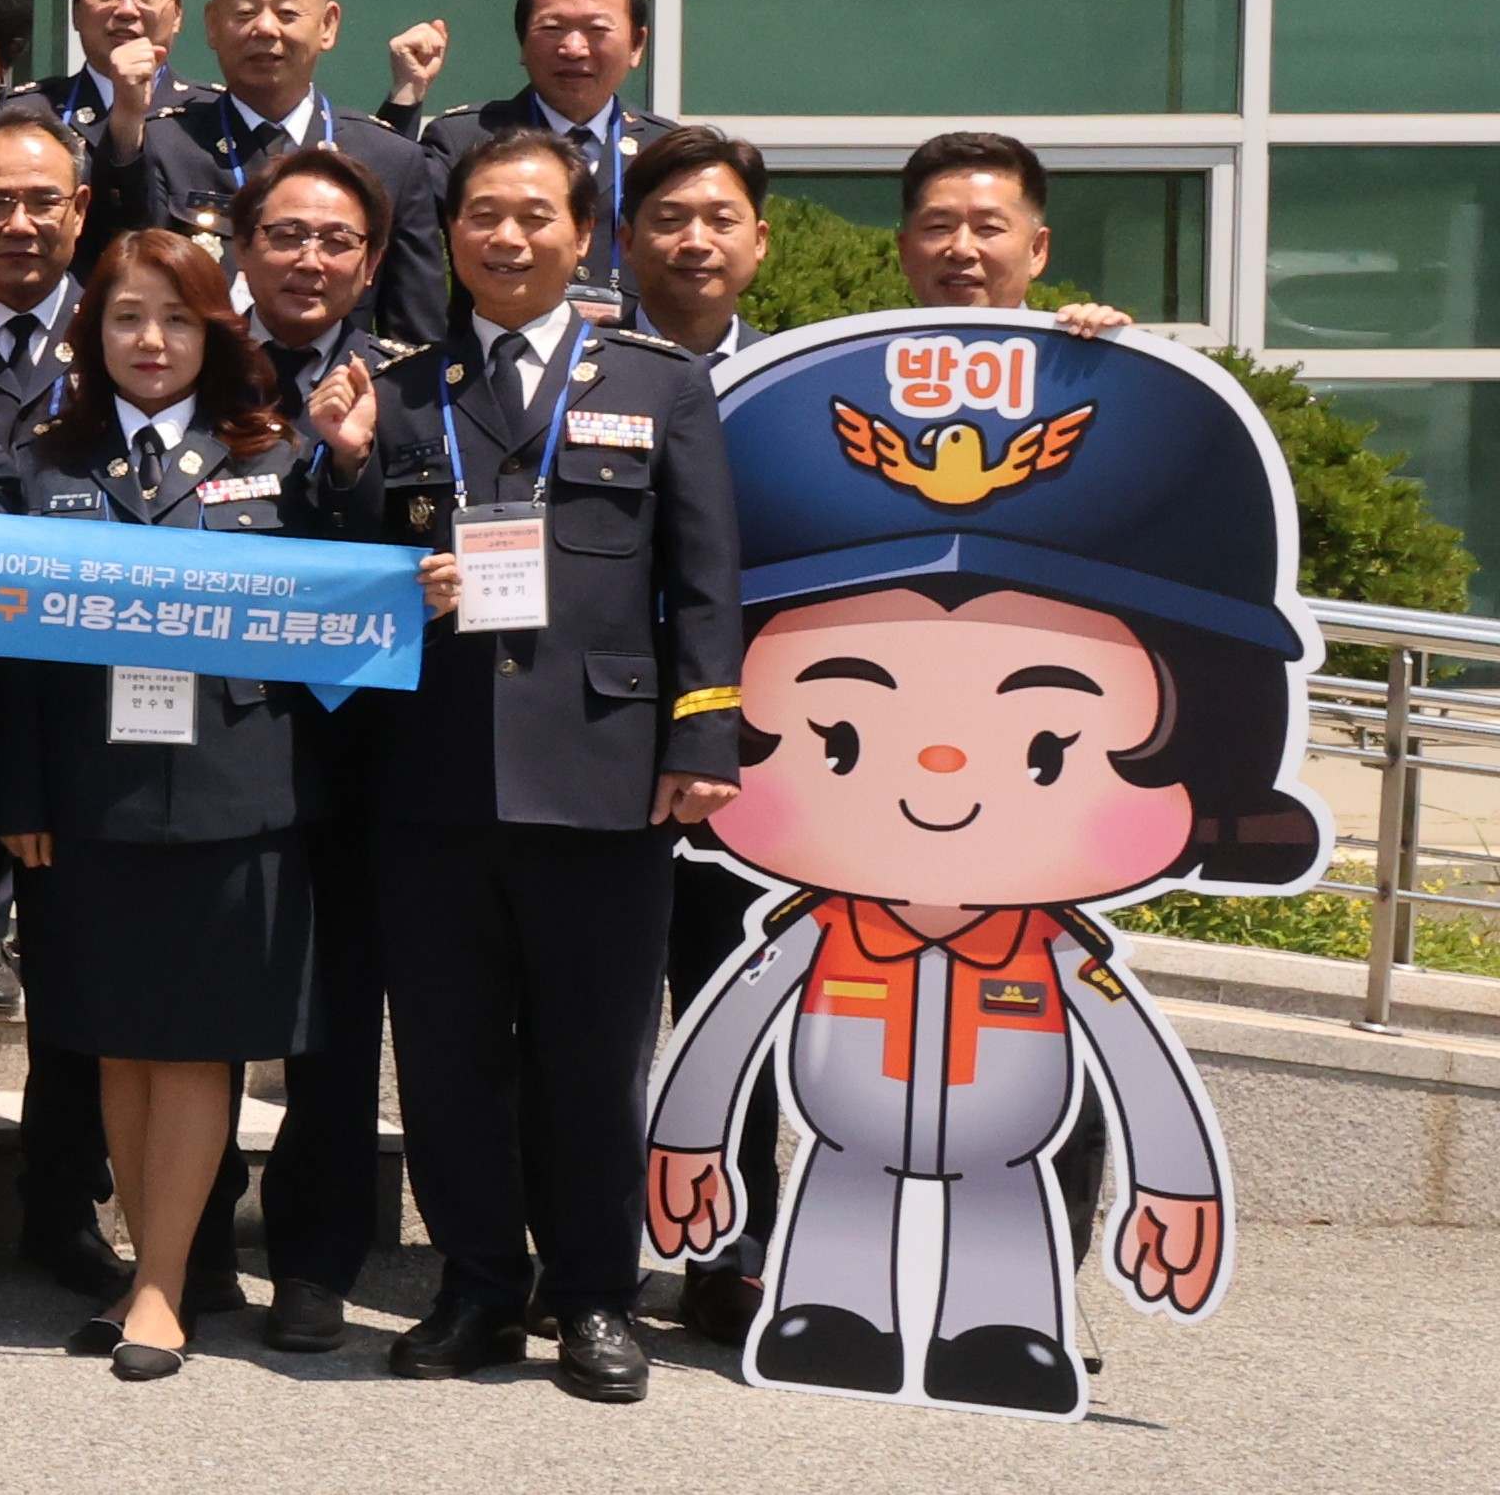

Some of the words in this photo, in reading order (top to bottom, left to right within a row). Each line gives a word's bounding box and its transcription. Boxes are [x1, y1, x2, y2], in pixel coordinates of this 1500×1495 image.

[898, 346, 1024, 409] 방이
[184, 570, 295, 594] 안전지킴이
[40, 593, 231, 640] 의용소방대
[242, 610, 396, 650] 교류행사
